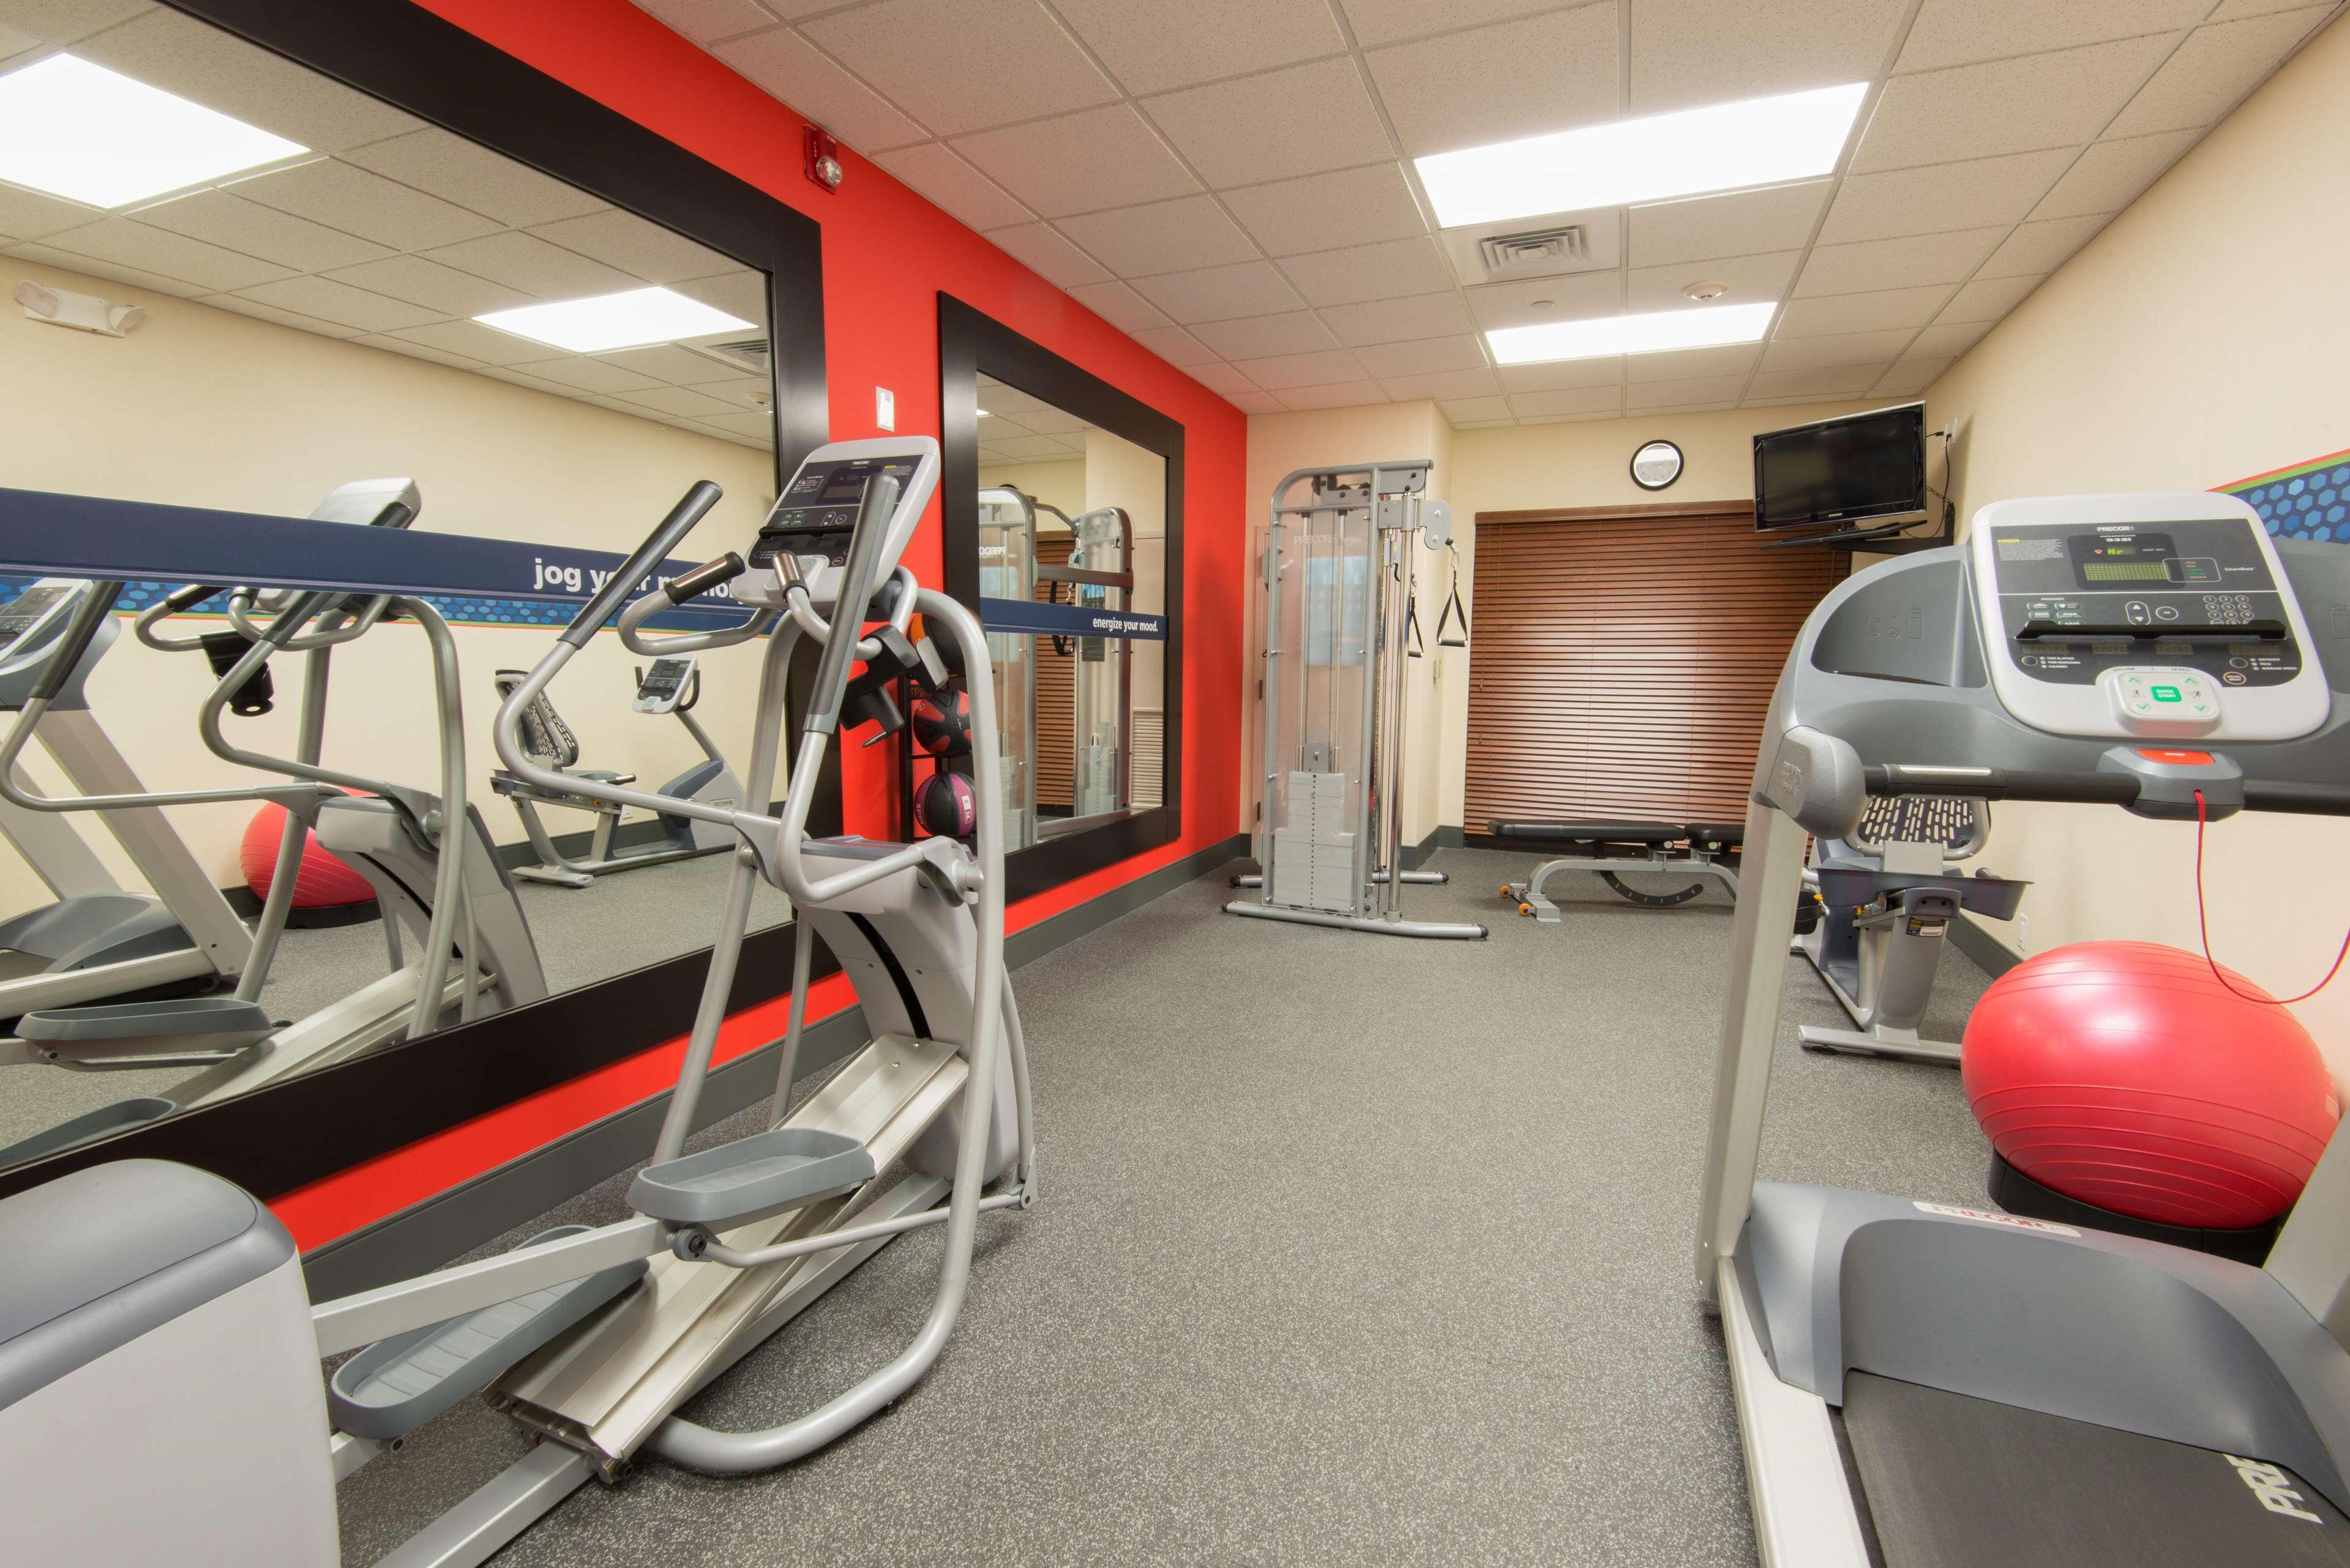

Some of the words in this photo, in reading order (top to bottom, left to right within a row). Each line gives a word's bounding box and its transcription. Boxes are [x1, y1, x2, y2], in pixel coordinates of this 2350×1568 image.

[534, 558, 582, 592] jog
[589, 569, 650, 594] yr
[1093, 617, 1122, 632] energize
[1123, 621, 1139, 633] your
[1139, 621, 1158, 632] mood.
[1931, 1204, 2044, 1229] PRECOR
